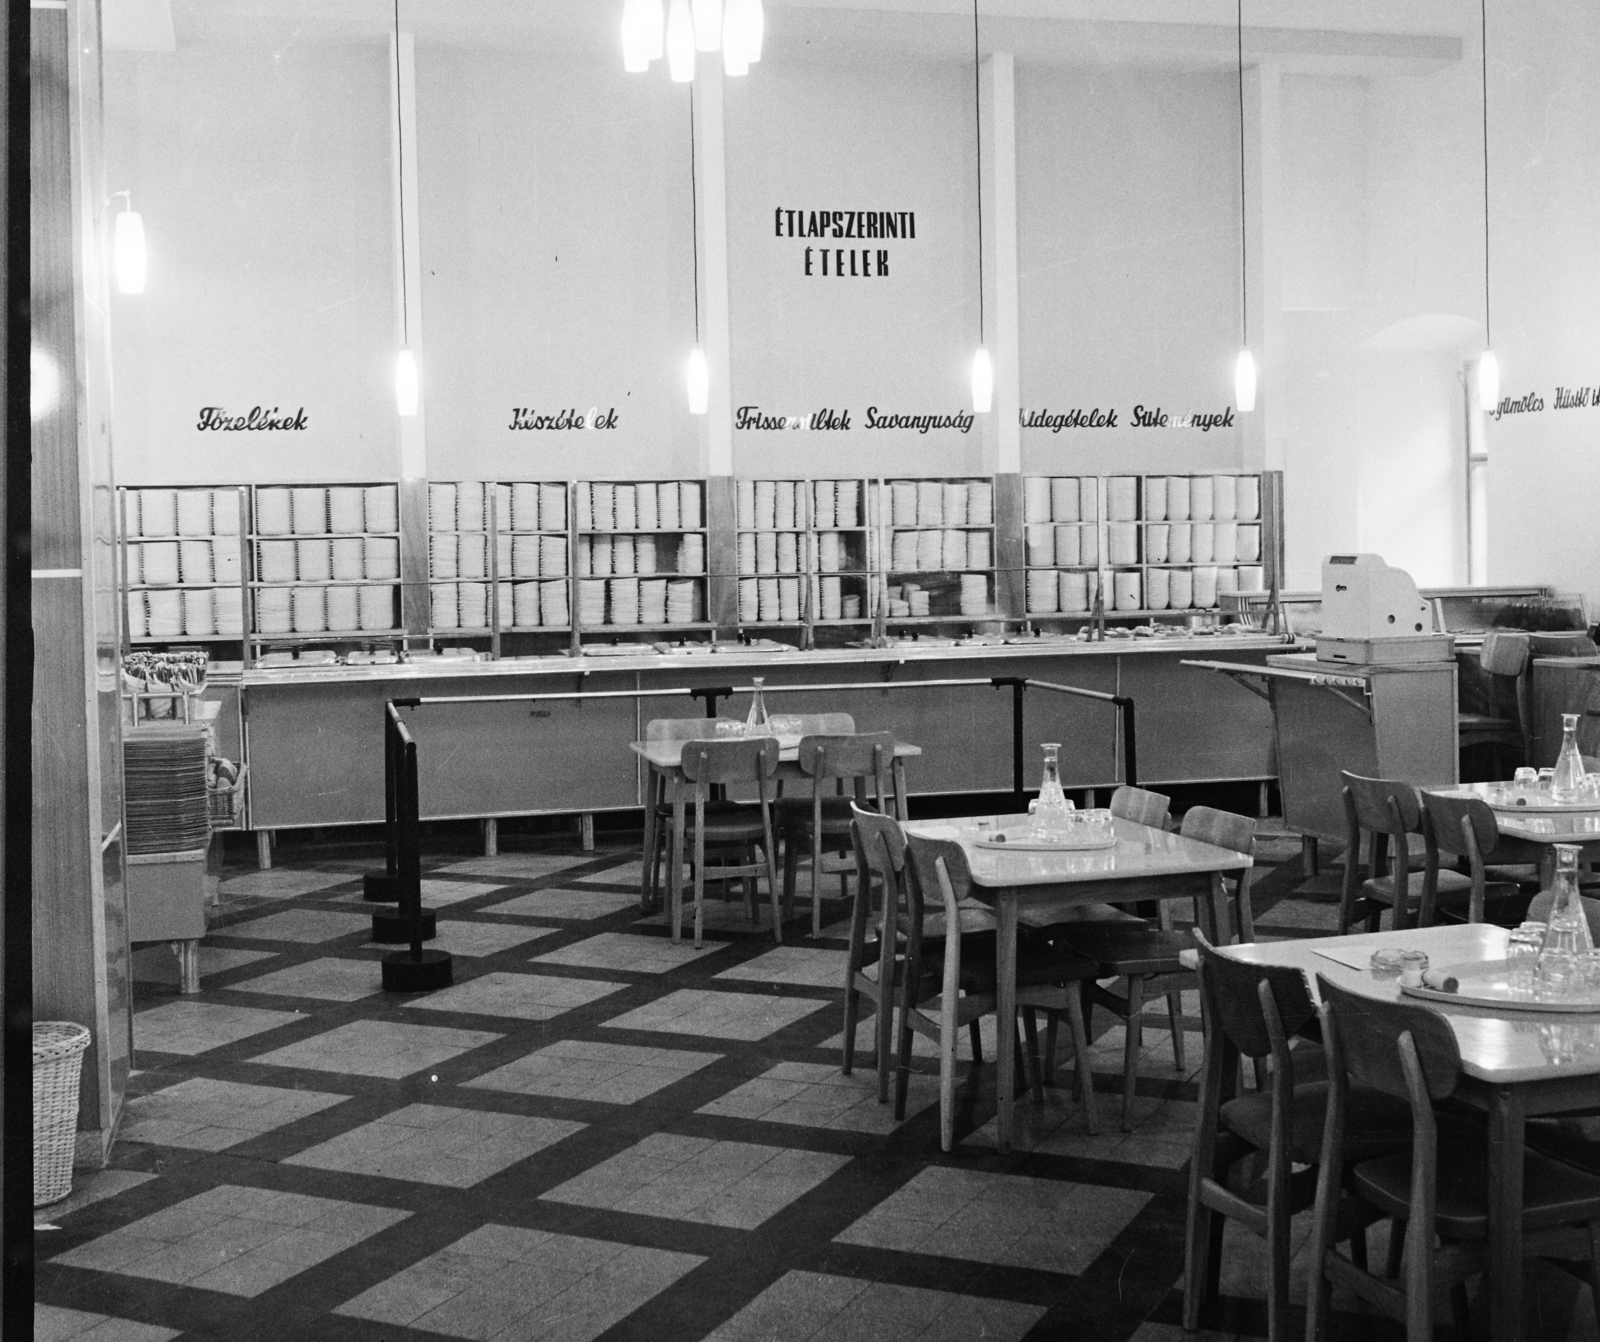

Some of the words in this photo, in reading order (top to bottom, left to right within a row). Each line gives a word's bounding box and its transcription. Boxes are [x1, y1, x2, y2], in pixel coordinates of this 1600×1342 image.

[775, 207, 915, 239] ÉTLAPSZERINTI
[805, 246, 889, 277] ÉTELEK
[197, 406, 308, 431] Főzelékek
[509, 407, 619, 430] Készételek
[865, 406, 974, 434] Savanyuság
[1130, 405, 1234, 432] Sütemények
[1489, 392, 1544, 421] yümölcs
